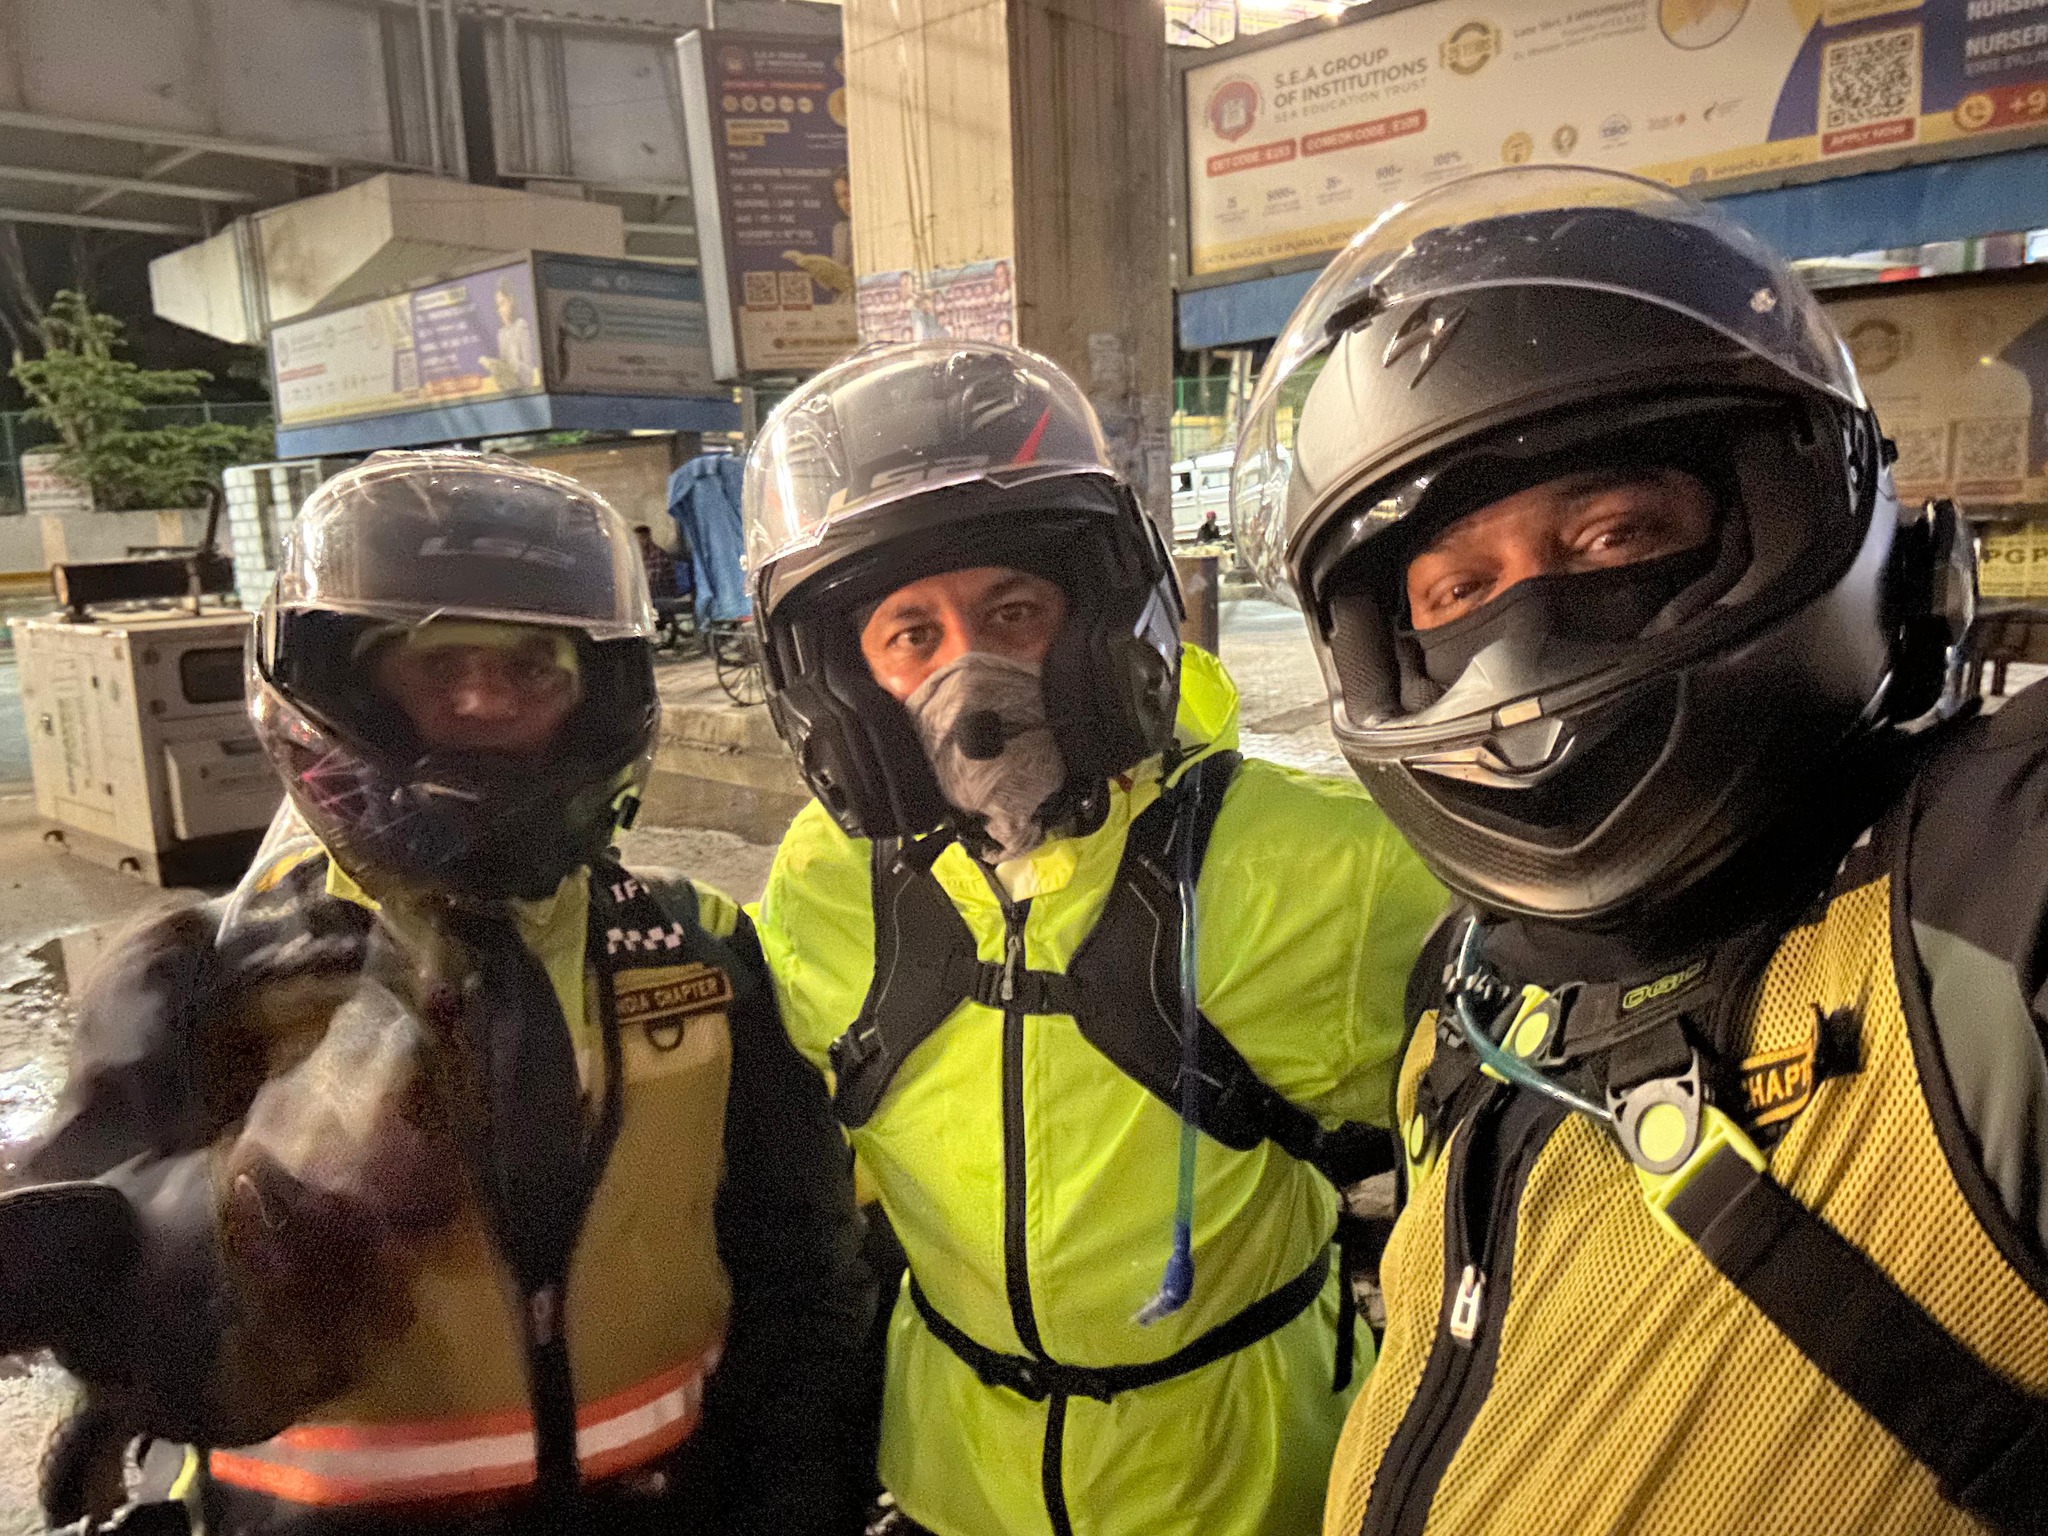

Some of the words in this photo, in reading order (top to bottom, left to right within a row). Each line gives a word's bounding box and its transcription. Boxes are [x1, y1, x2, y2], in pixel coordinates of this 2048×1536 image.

[1273, 66, 1318, 89] S.E.A
[1322, 47, 1389, 77] GROUP
[1273, 90, 1298, 109] OF
[1301, 56, 1429, 101] INSTITUTIONS
[1273, 110, 1298, 123] SEA
[1301, 91, 1381, 116] EDUCATION
[1384, 76, 1428, 96] TRUST
